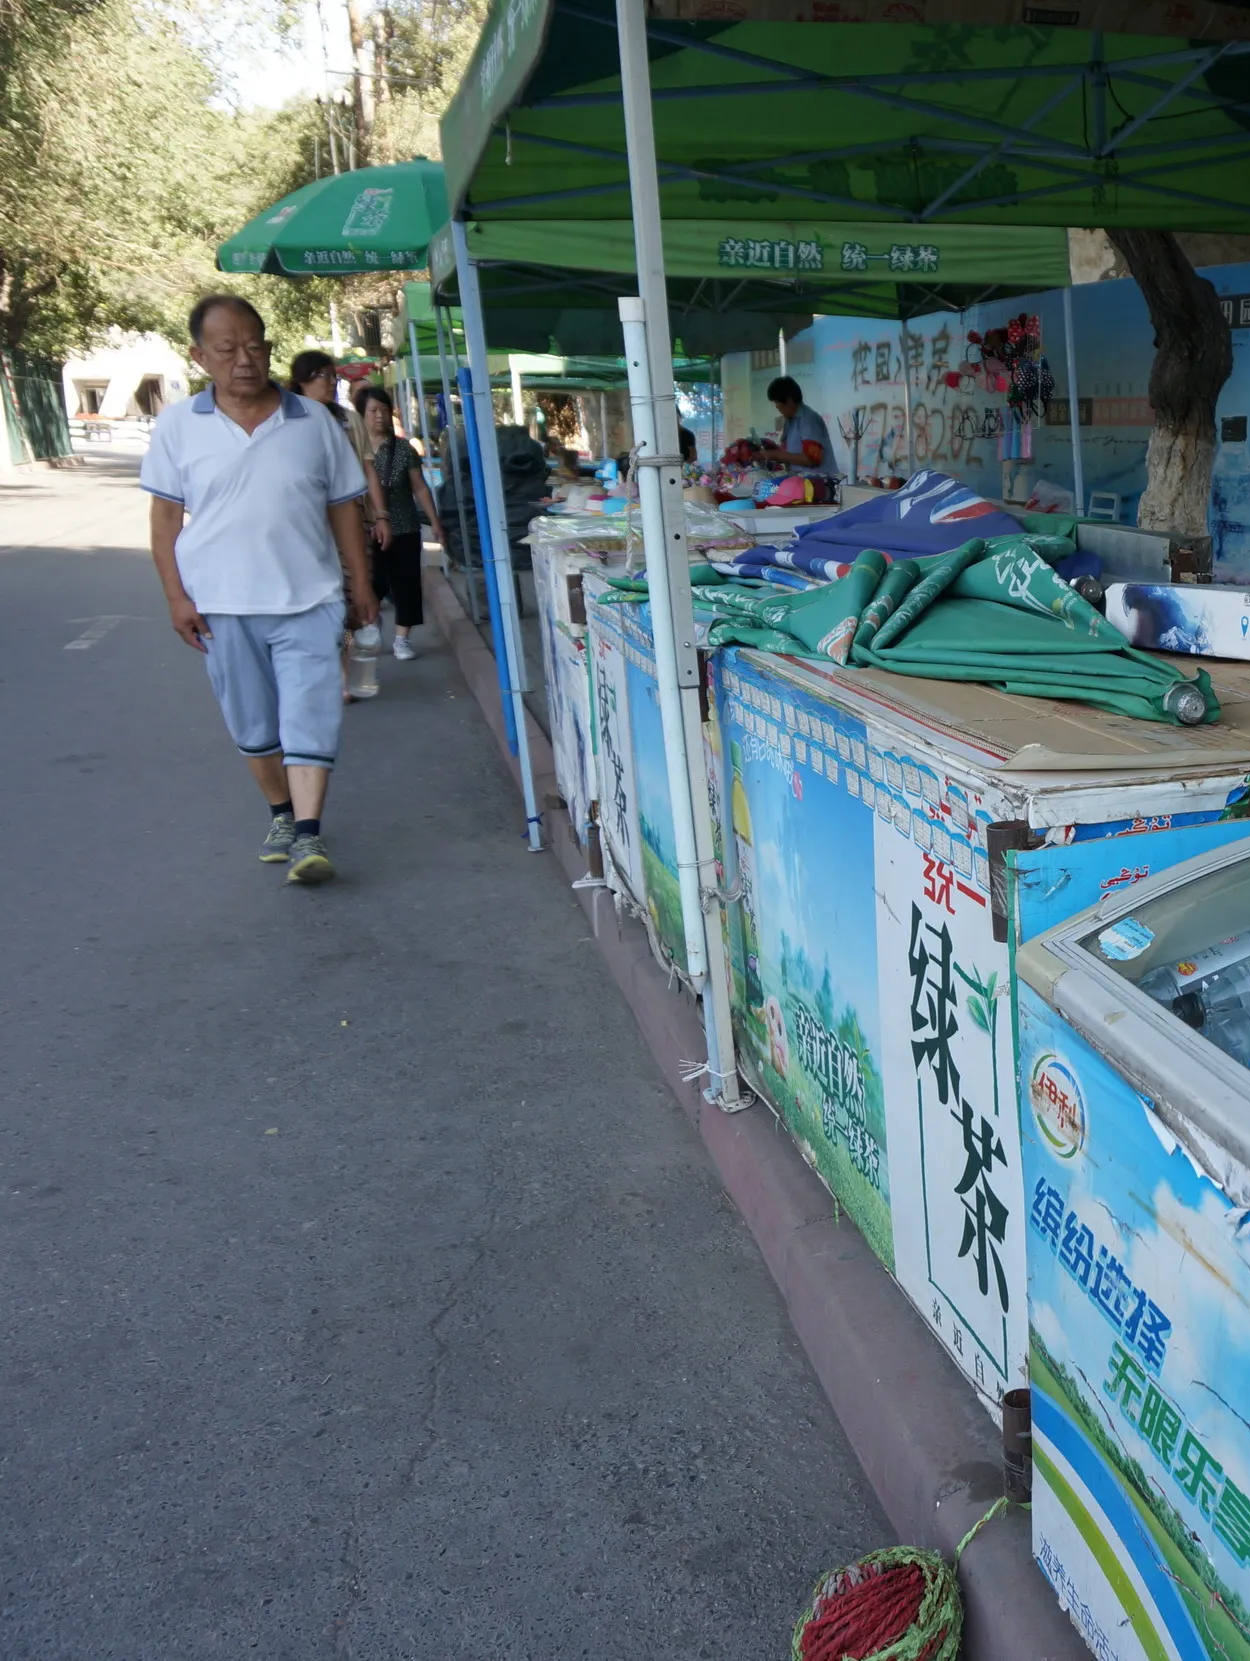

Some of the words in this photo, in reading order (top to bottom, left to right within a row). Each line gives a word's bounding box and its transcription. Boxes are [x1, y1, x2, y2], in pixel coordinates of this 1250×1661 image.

[719, 238, 823, 270] 亲近自然
[840, 242, 940, 273] 统一绿茶
[922, 851, 987, 916] 统一
[795, 1004, 868, 1126] 亲近自然
[907, 899, 1010, 1313] 绿茶
[1036, 1070, 1082, 1130] 伊利
[1029, 1175, 1173, 1378] 缤纷选择
[1039, 1531, 1119, 1661] 滋养生命活
